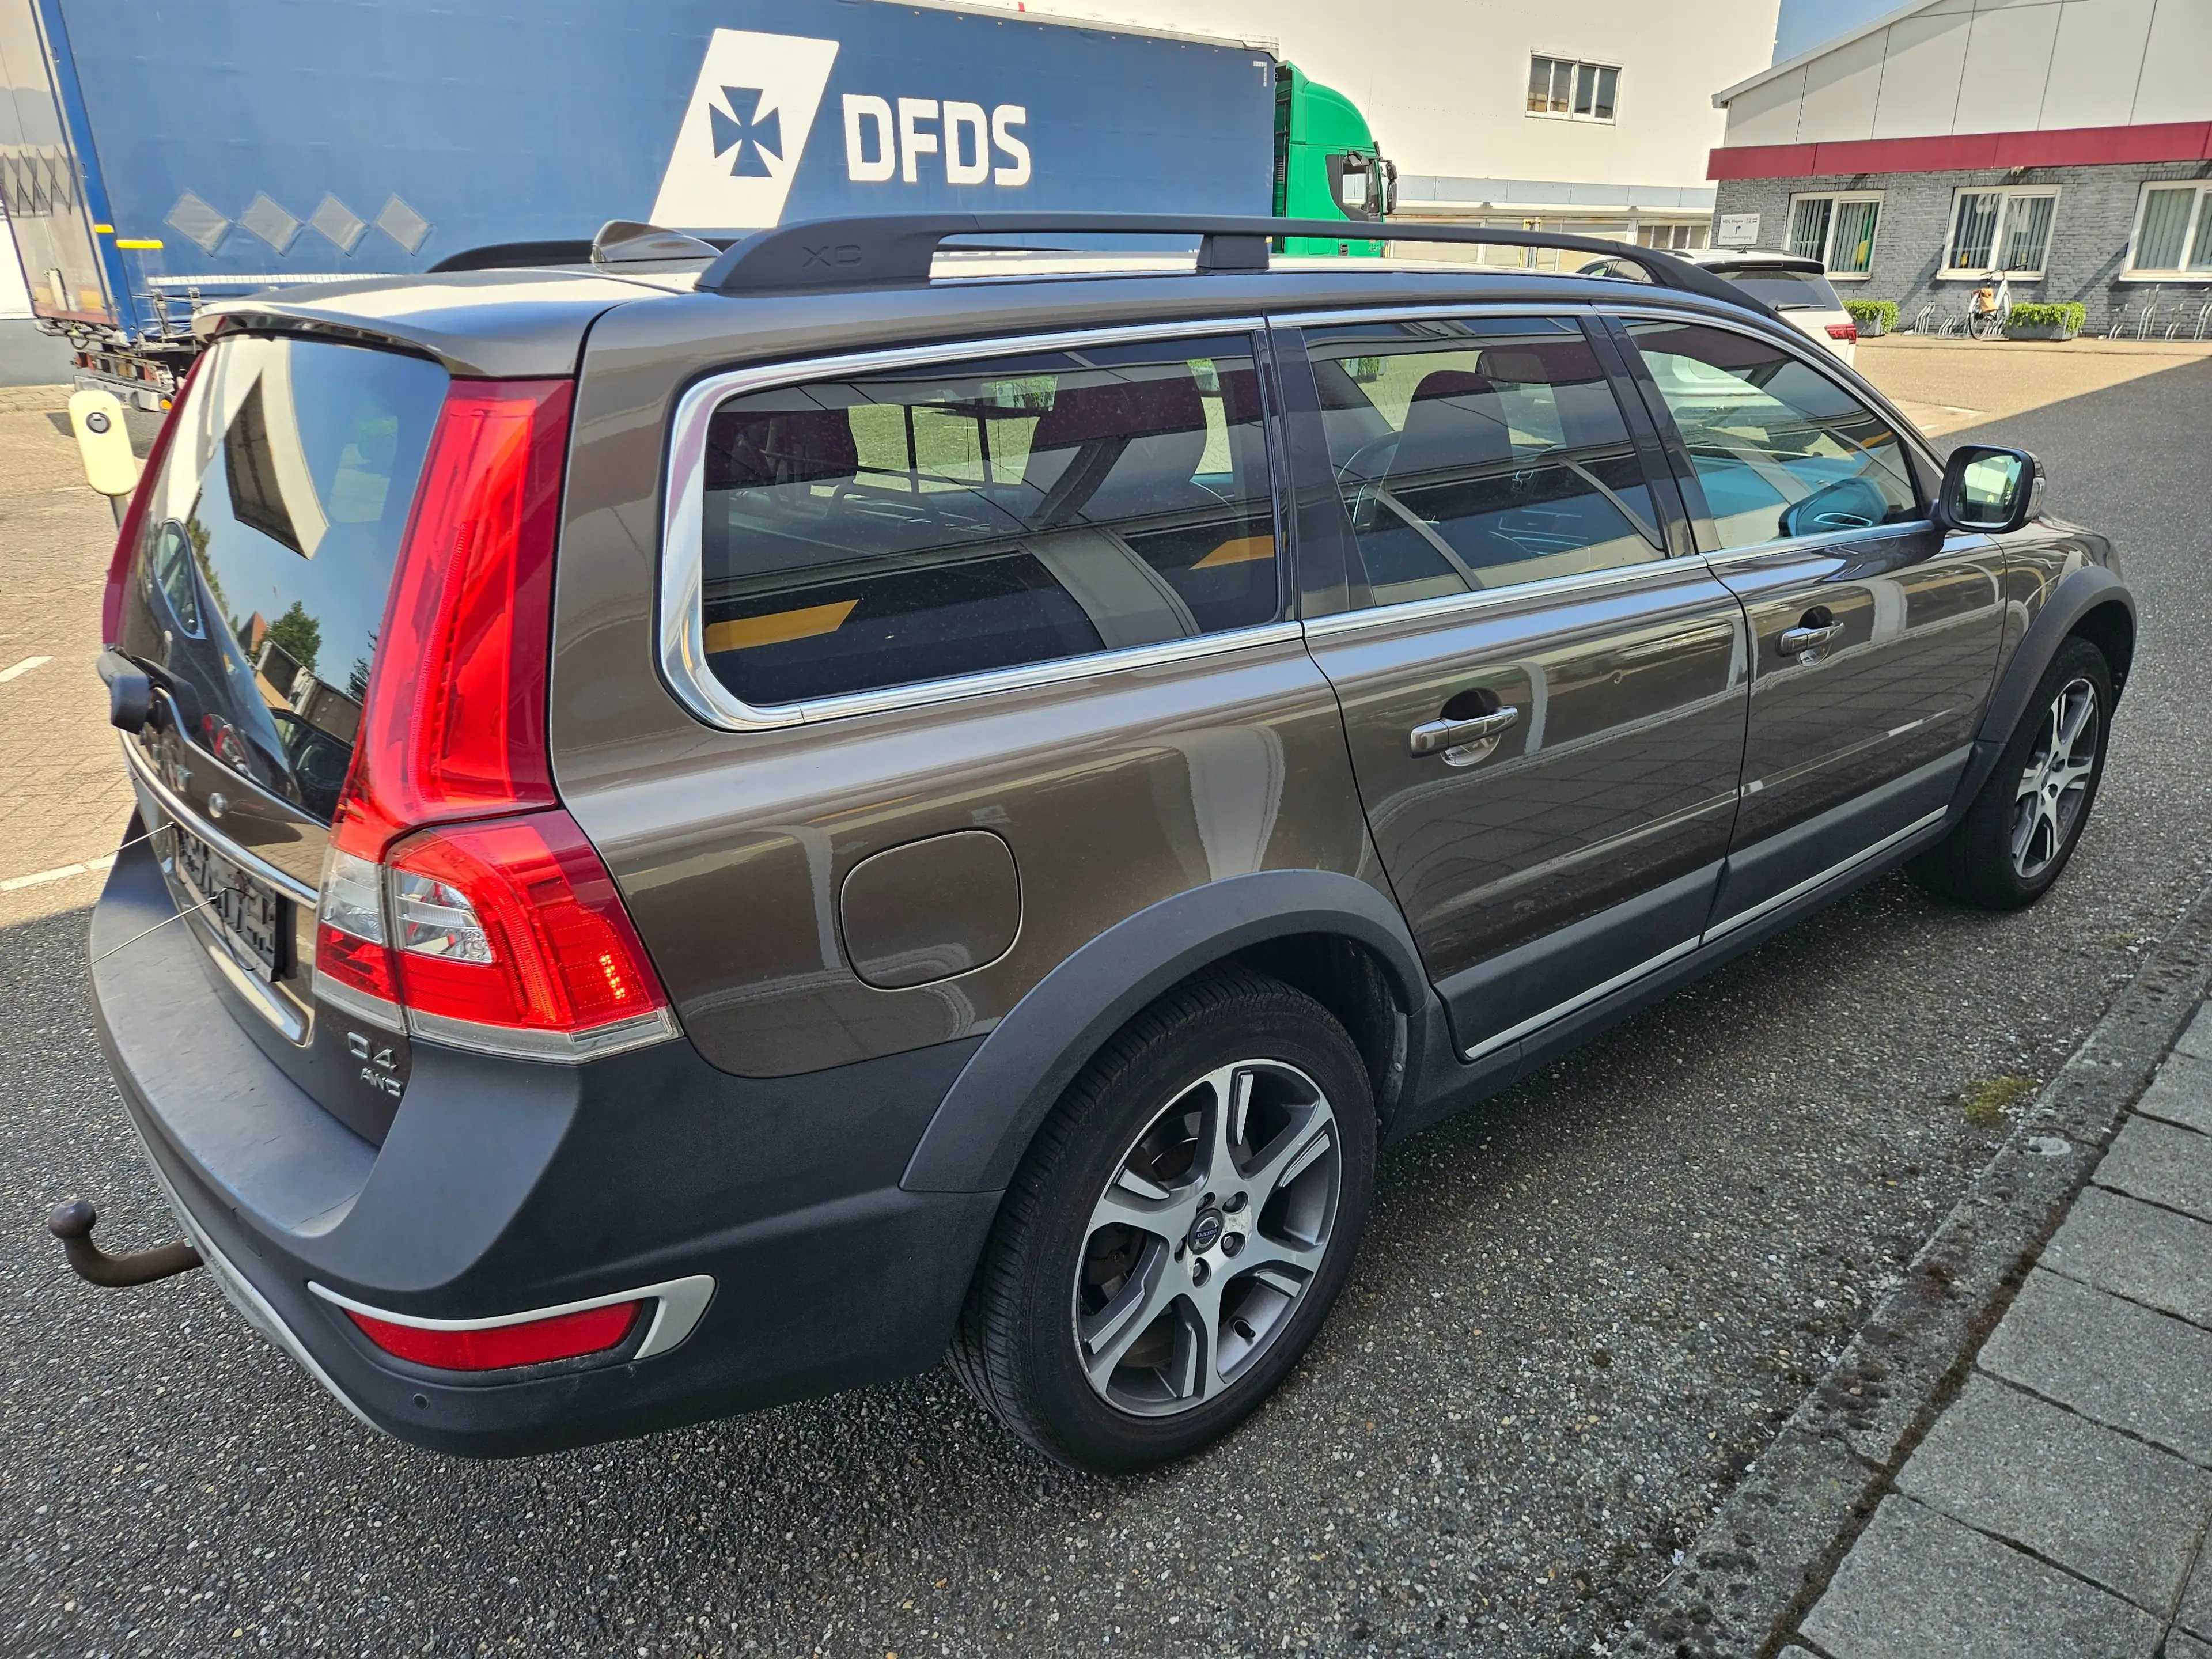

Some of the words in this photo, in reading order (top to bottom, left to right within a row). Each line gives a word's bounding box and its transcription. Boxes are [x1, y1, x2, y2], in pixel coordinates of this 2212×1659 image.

[843, 94, 1031, 186] DFDS
[801, 245, 862, 268] XC
[347, 1031, 397, 1071] D4
[360, 1067, 404, 1097] AWD
